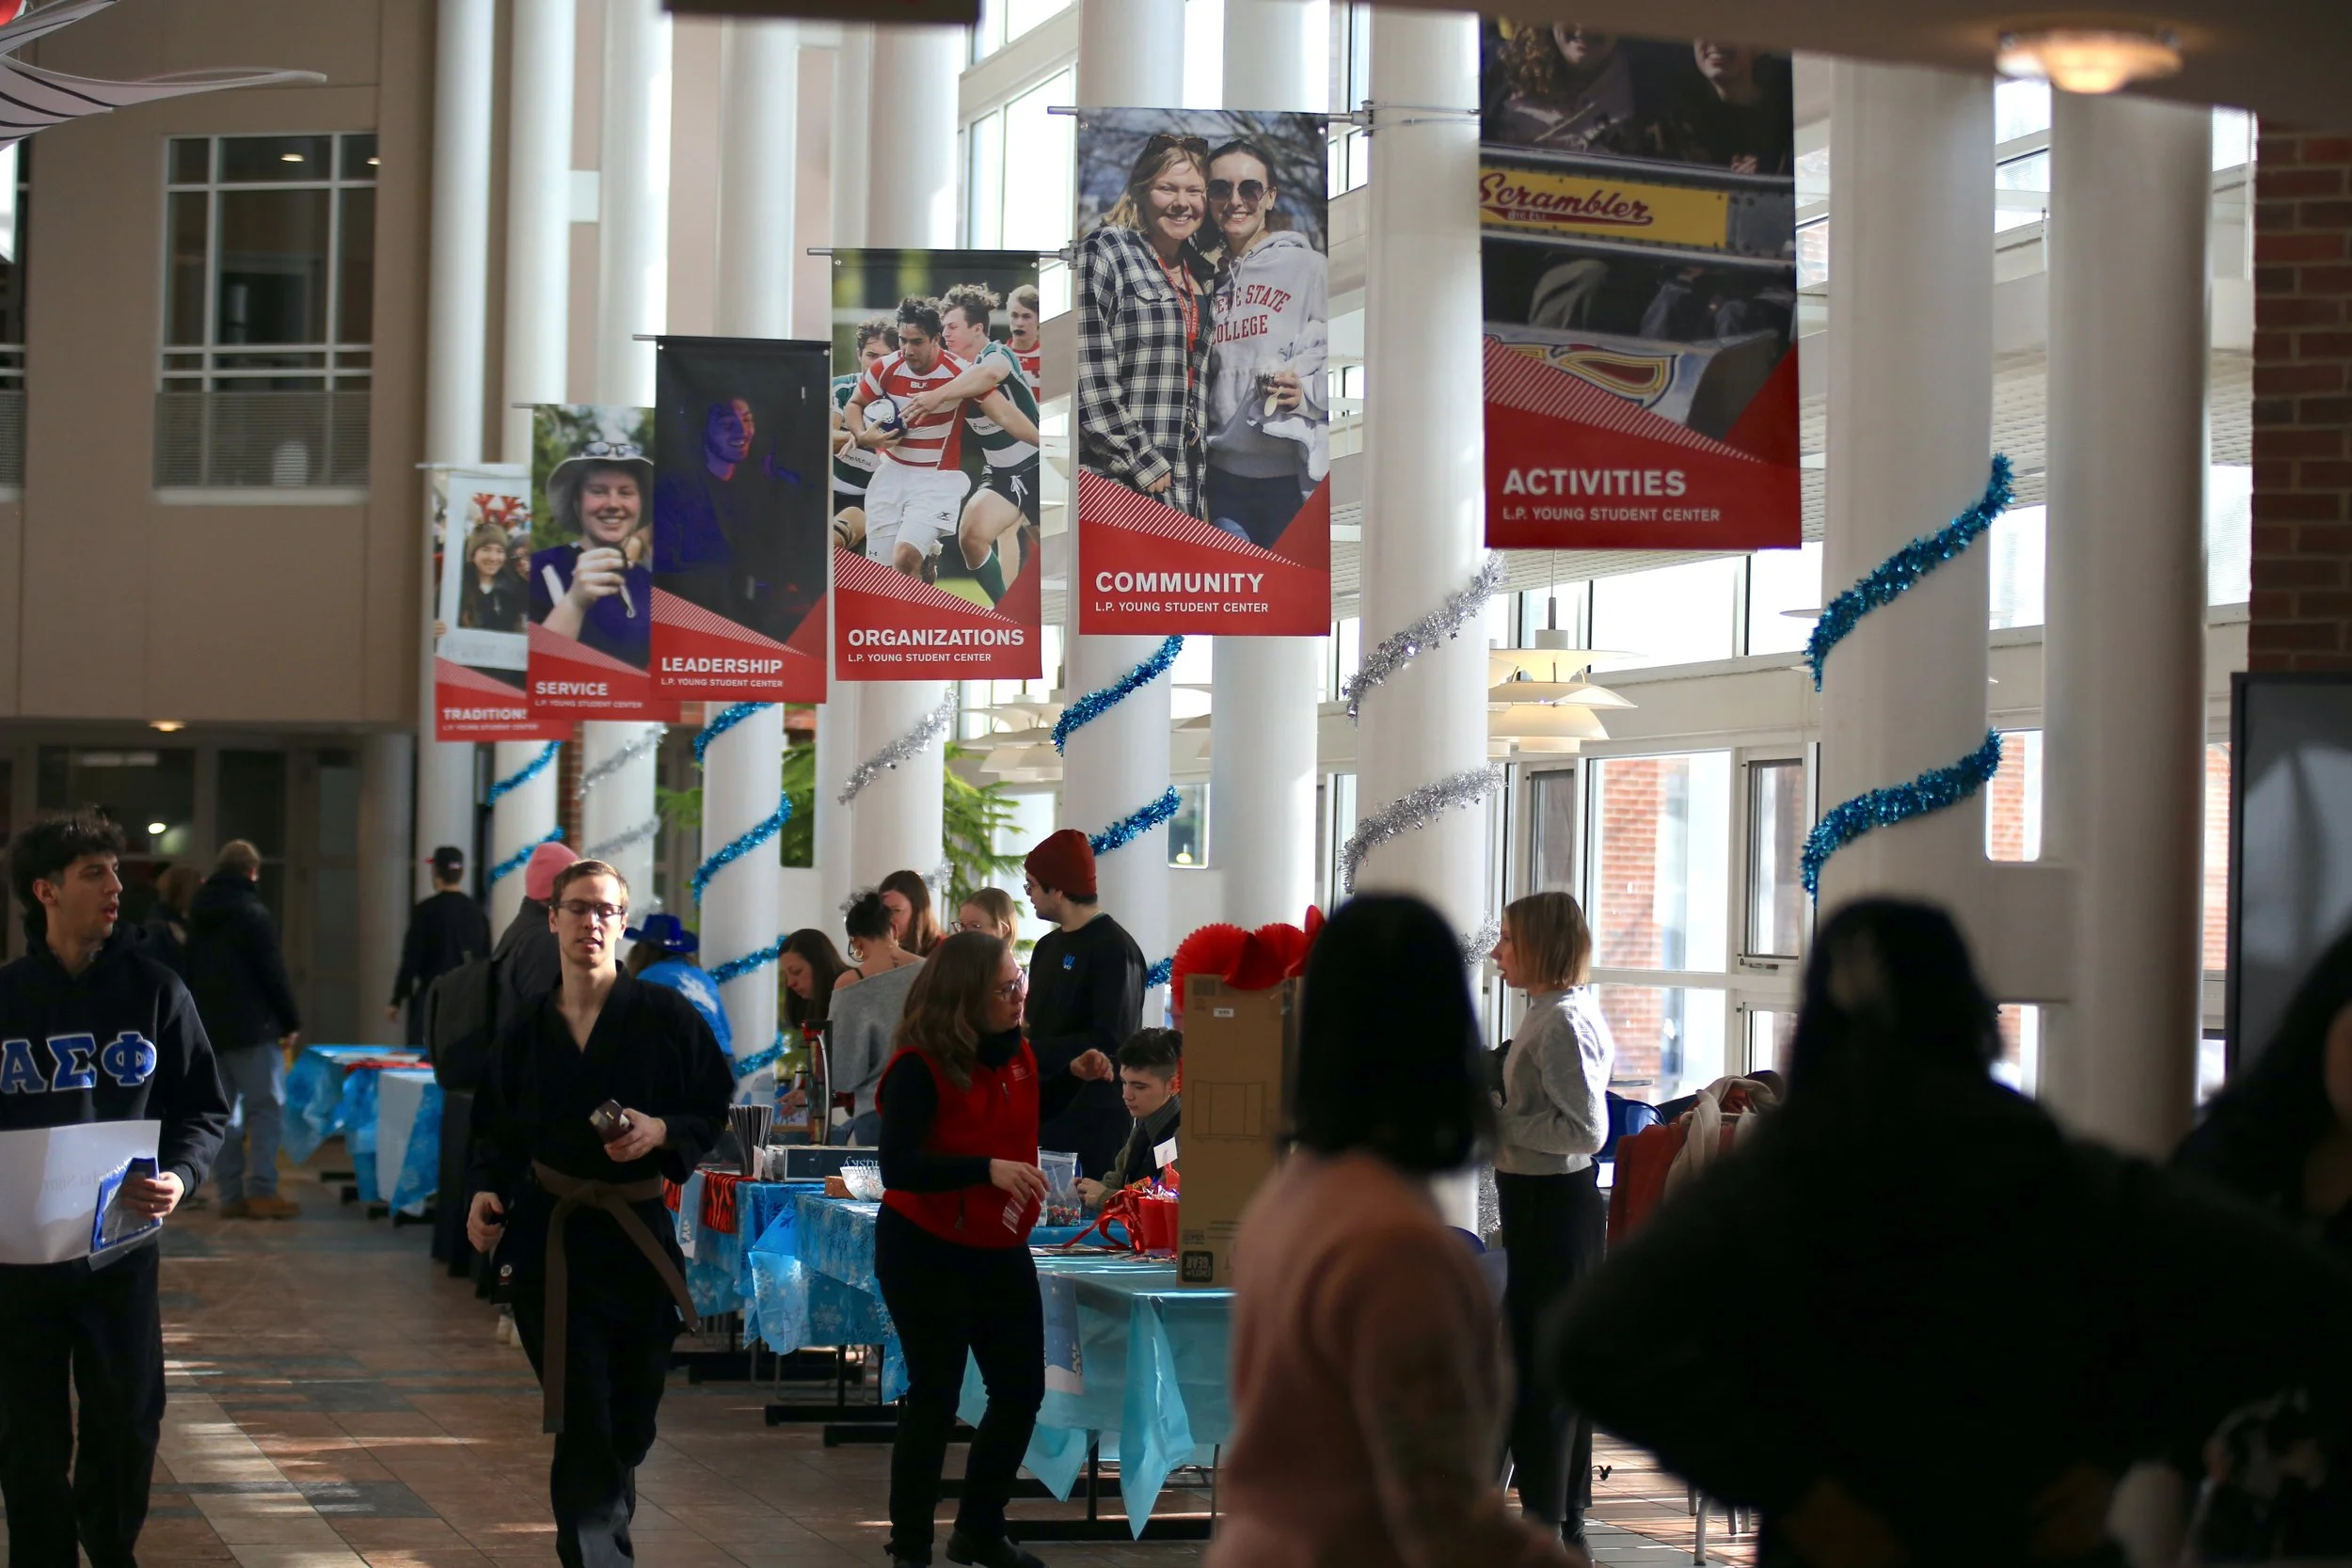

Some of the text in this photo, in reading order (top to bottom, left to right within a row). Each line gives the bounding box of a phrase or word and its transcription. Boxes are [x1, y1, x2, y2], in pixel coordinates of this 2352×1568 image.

[1480, 172, 1653, 223] Scrambler
[1246, 284, 1292, 312] STATE
[1211, 314, 1268, 345] COLLEGE
[1502, 468, 1687, 497] ACTIVITIES
[1502, 507, 1721, 523] L.P. YOUNG STUDENT CENTER
[1095, 571, 1264, 594] COMMUNITY
[1095, 602, 1269, 613] L.P. YOUNG STUDENT CENTER
[848, 628, 1025, 646] ORGANIZATIONS
[661, 657, 784, 674] LEADERSHIP
[848, 654, 992, 662] L.P. YOUNG STUDENT CENTER
[535, 681, 609, 696] SERVICE
[660, 677, 784, 689] L.P. YOUNG STUDENT CENTER
[549, 700, 576, 708] YOUNG
[578, 700, 612, 708] STUDENT
[613, 701, 644, 709] CENTER
[1186, 1256, 1209, 1269] GEAR
